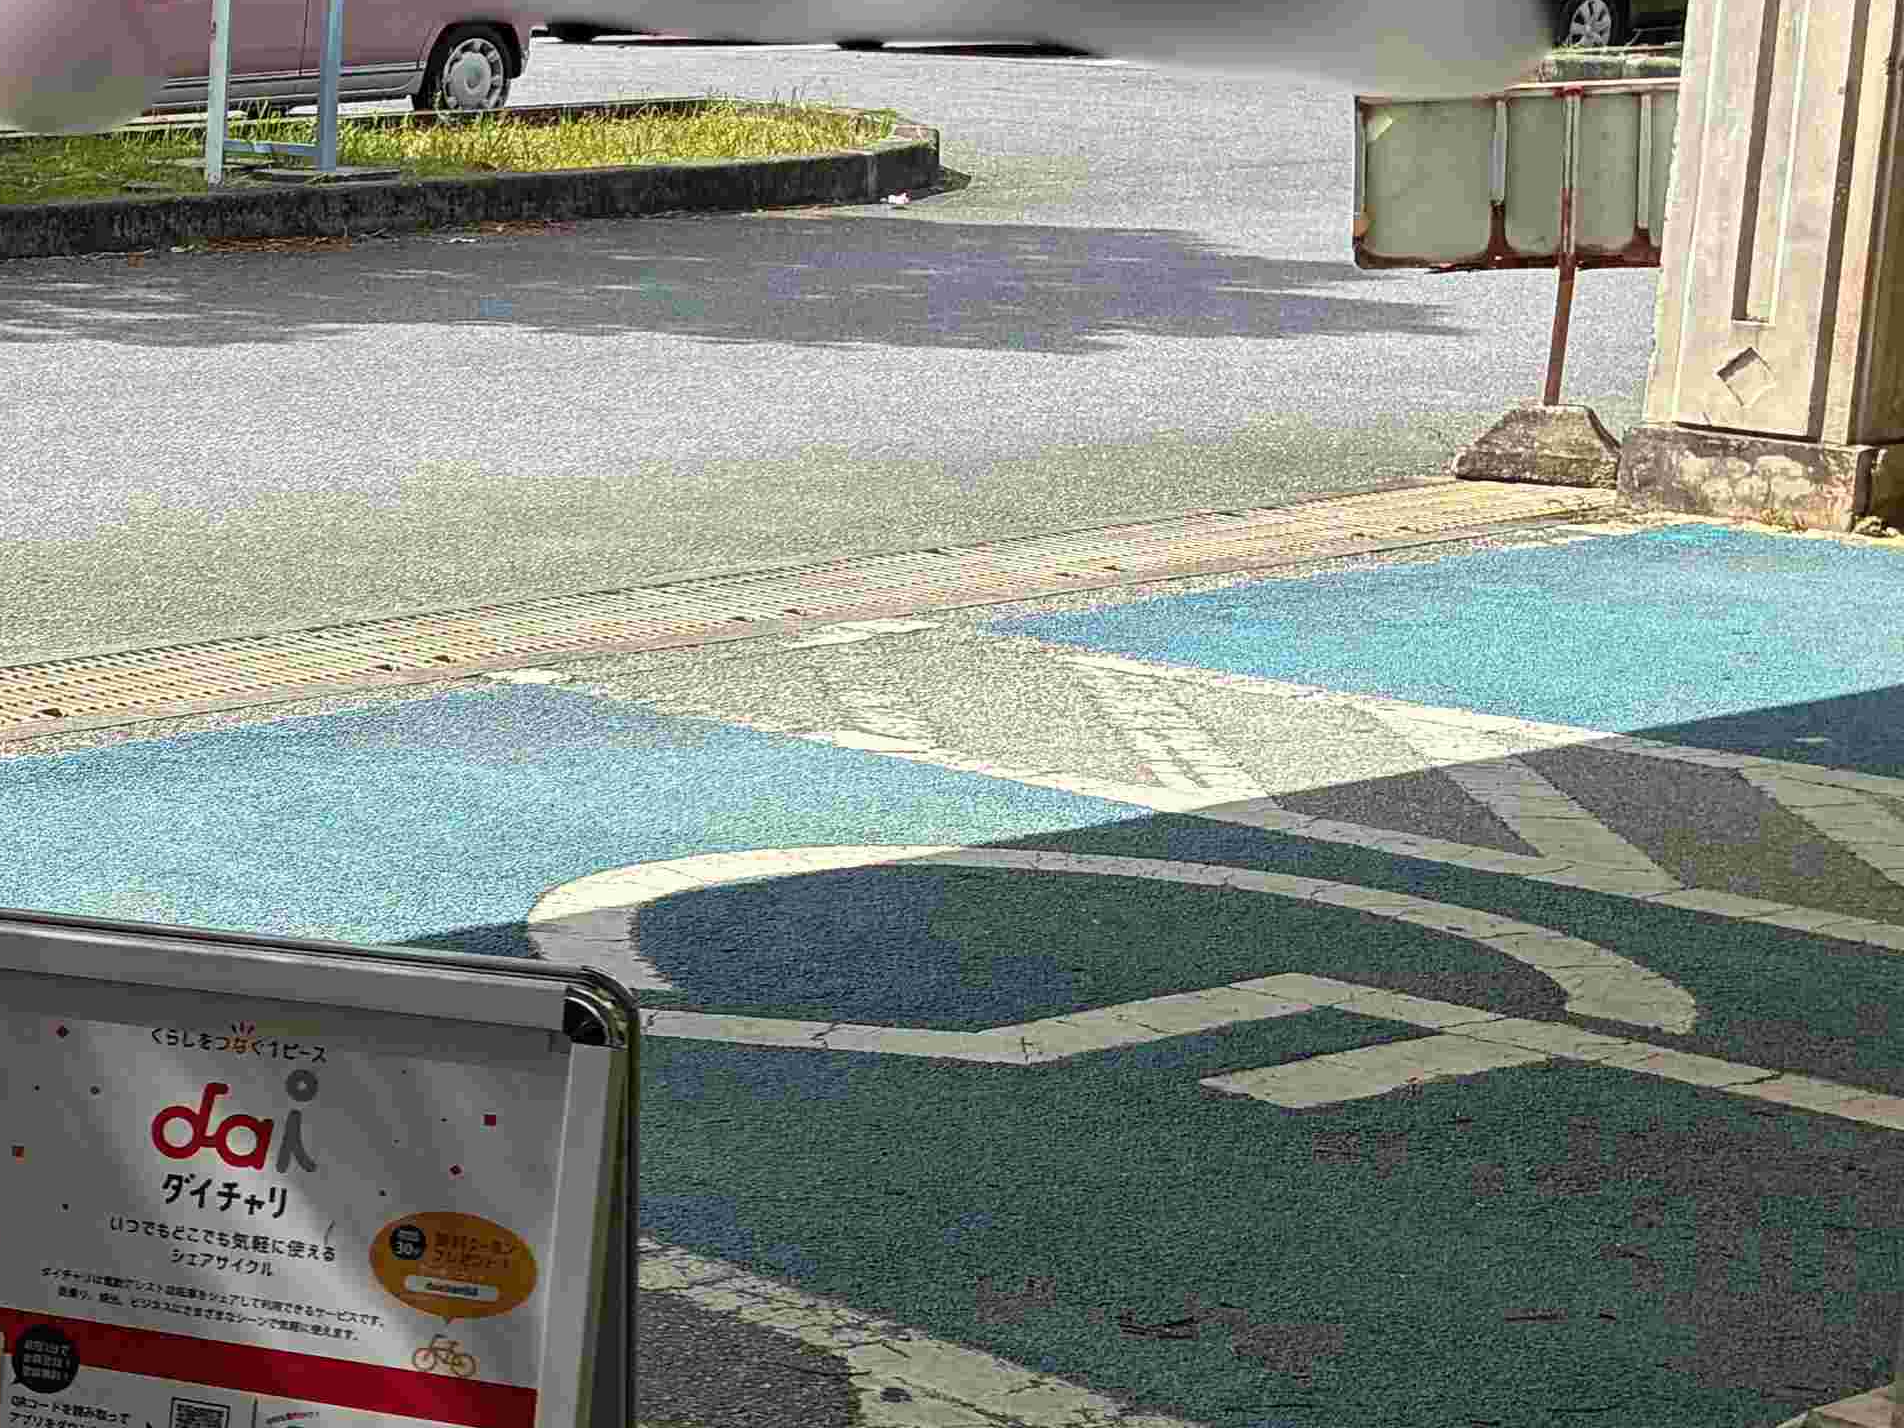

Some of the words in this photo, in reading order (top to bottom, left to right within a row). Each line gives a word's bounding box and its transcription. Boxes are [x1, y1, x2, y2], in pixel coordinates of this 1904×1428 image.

[151, 1069, 319, 1173] dai
[162, 1173, 288, 1219] ダイチャリ
[109, 1217, 337, 1262] いつでもどこでも気軽に使える
[170, 1249, 274, 1277] シェアサイクル
